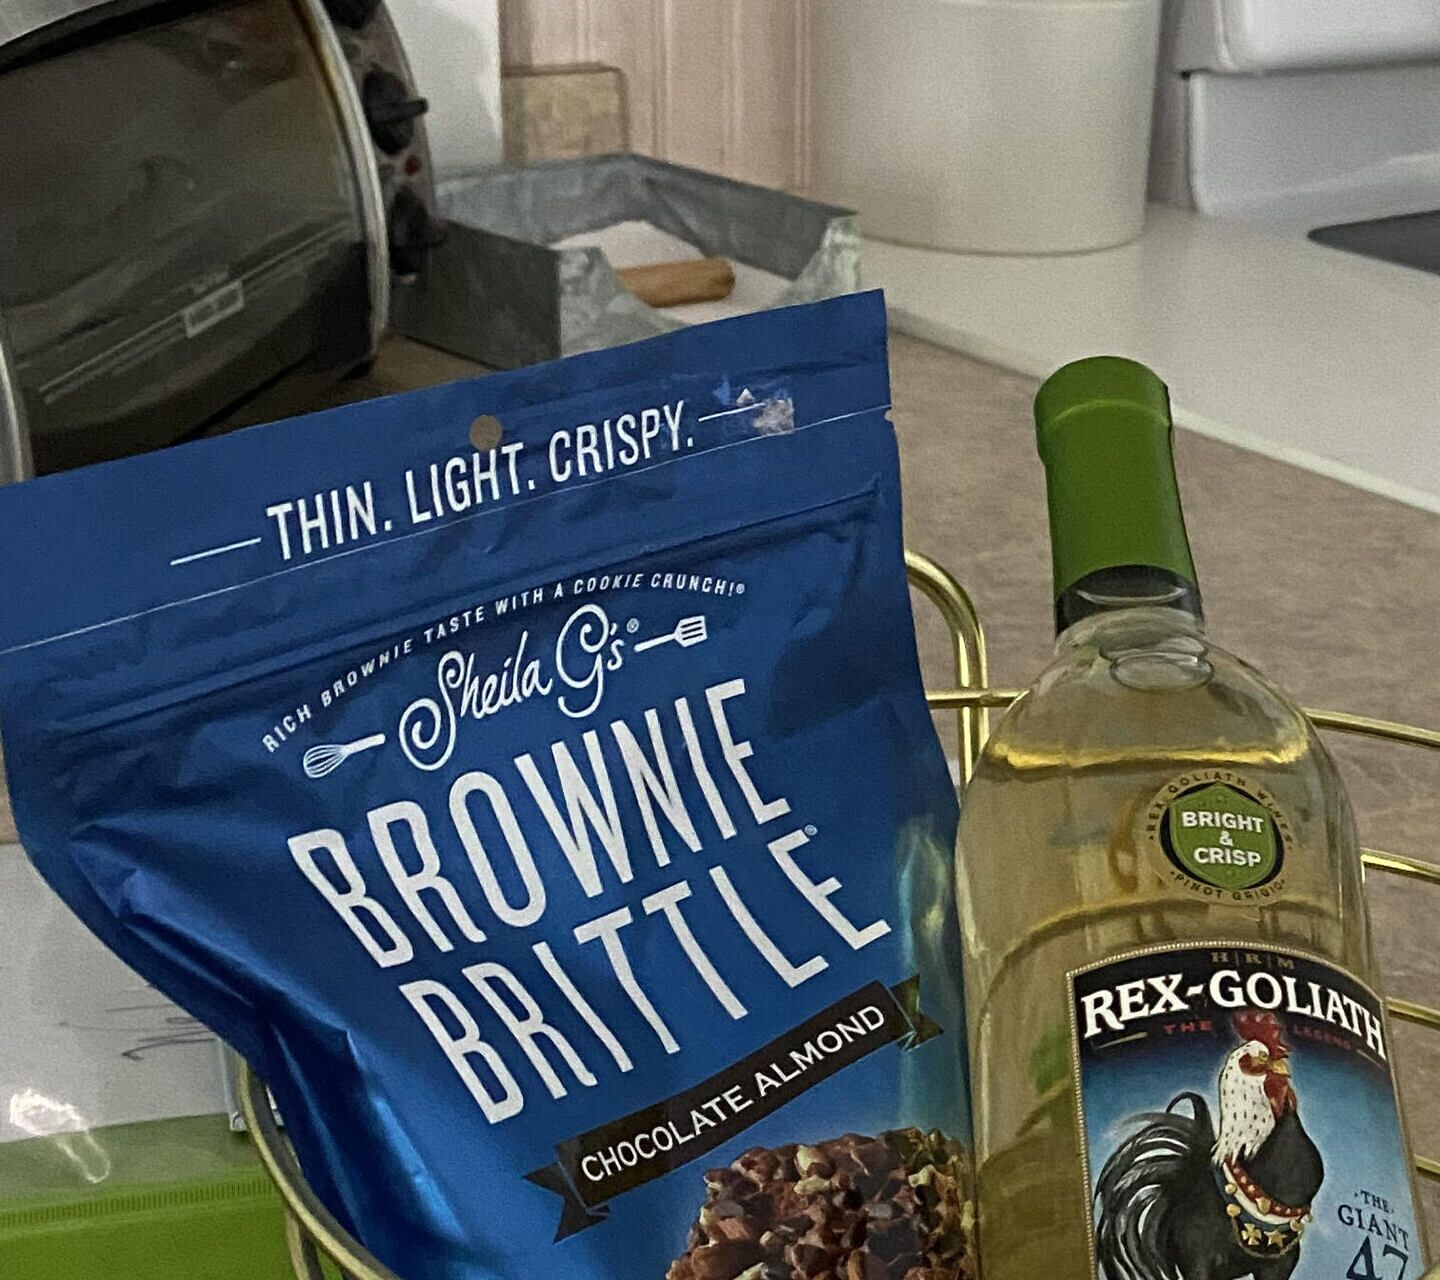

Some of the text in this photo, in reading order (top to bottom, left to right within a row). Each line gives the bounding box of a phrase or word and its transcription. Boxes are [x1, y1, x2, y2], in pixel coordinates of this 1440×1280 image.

[267, 399, 694, 561] THIN. LIGHT. CRISPY.
[262, 704, 313, 753] RICH
[320, 638, 413, 708] BROWNIE
[424, 605, 485, 644] TASTE
[495, 586, 544, 615] WITH
[553, 583, 565, 598] A
[573, 573, 644, 596] COOKIE
[400, 631, 553, 772] Sheila
[1167, 771, 1247, 794] GOLIATH
[287, 678, 791, 969] BROWNIE
[1181, 810, 1265, 834] BRIGHT
[1219, 830, 1234, 847] &
[1193, 847, 1262, 868] CRISP
[1174, 873, 1223, 900] PINOT
[1080, 969, 1387, 1061] REX-GOLIATH
[1163, 1020, 1213, 1036] THE
[580, 1004, 886, 1182] CHOCOLATE ALMOND
[1337, 1204, 1409, 1251] GIANT
